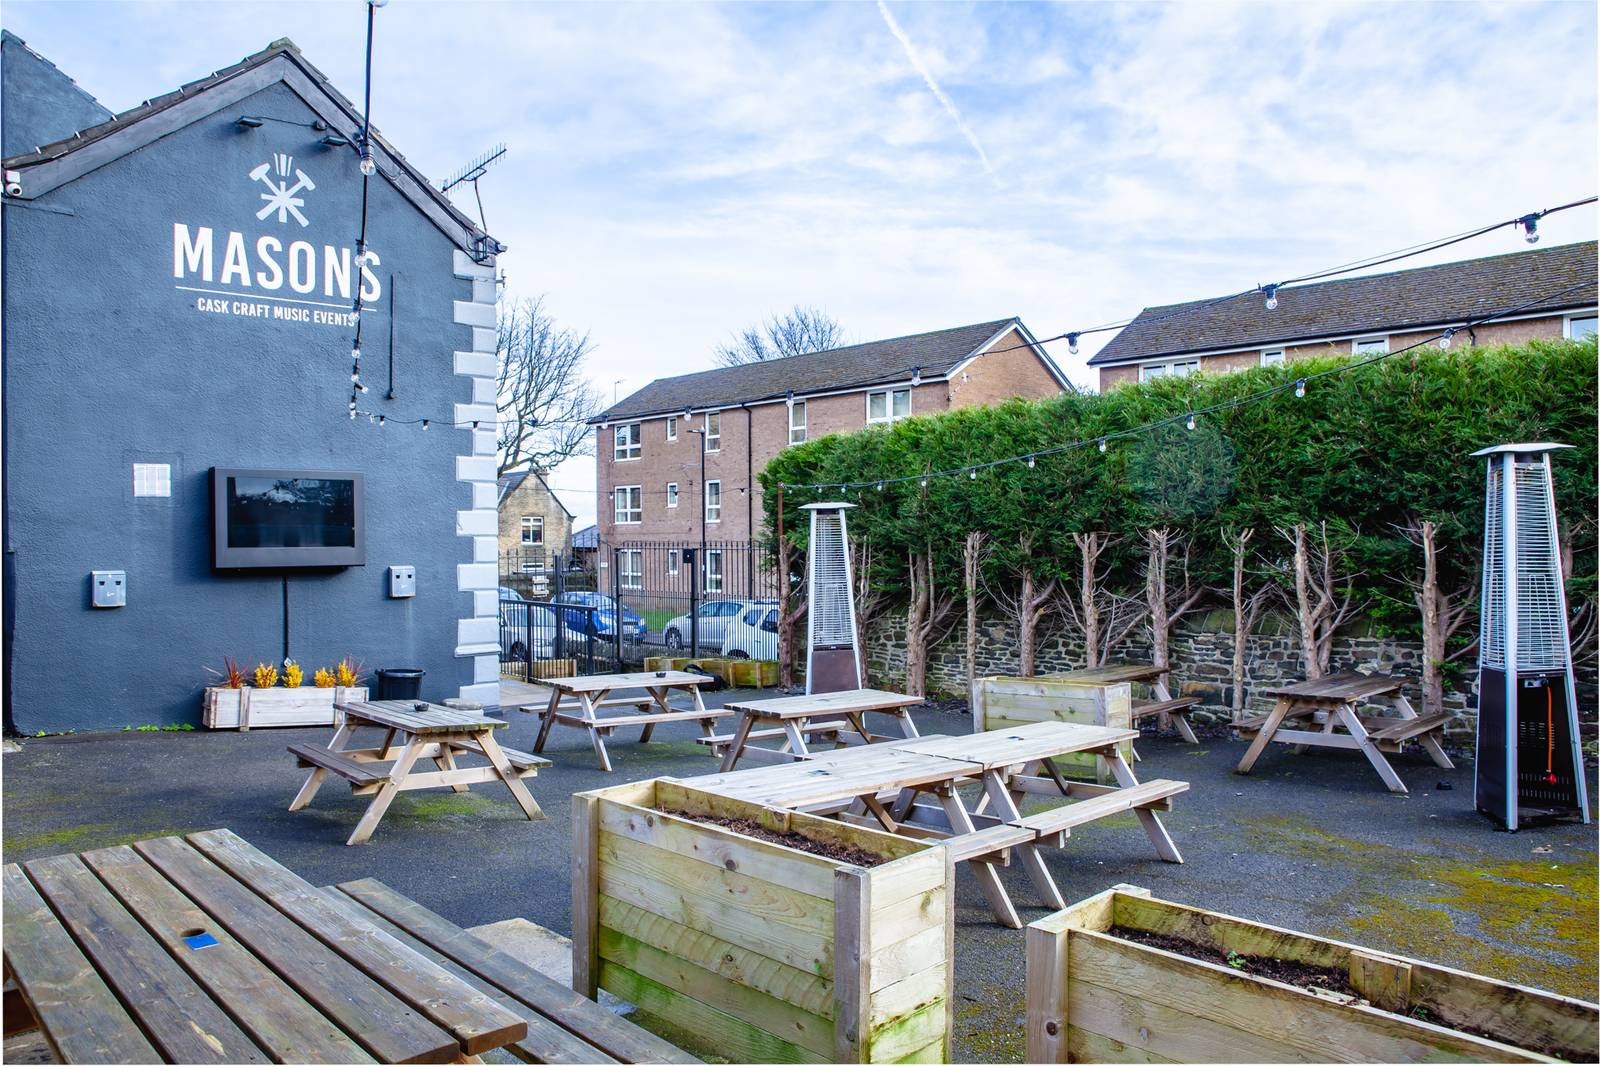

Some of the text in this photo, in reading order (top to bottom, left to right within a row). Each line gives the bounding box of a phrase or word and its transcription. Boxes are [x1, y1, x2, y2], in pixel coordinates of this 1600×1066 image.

[174, 223, 381, 302] MASONS
[198, 298, 229, 314] CASK
[233, 302, 270, 318] CRAFT
[274, 306, 310, 322] MUSIC
